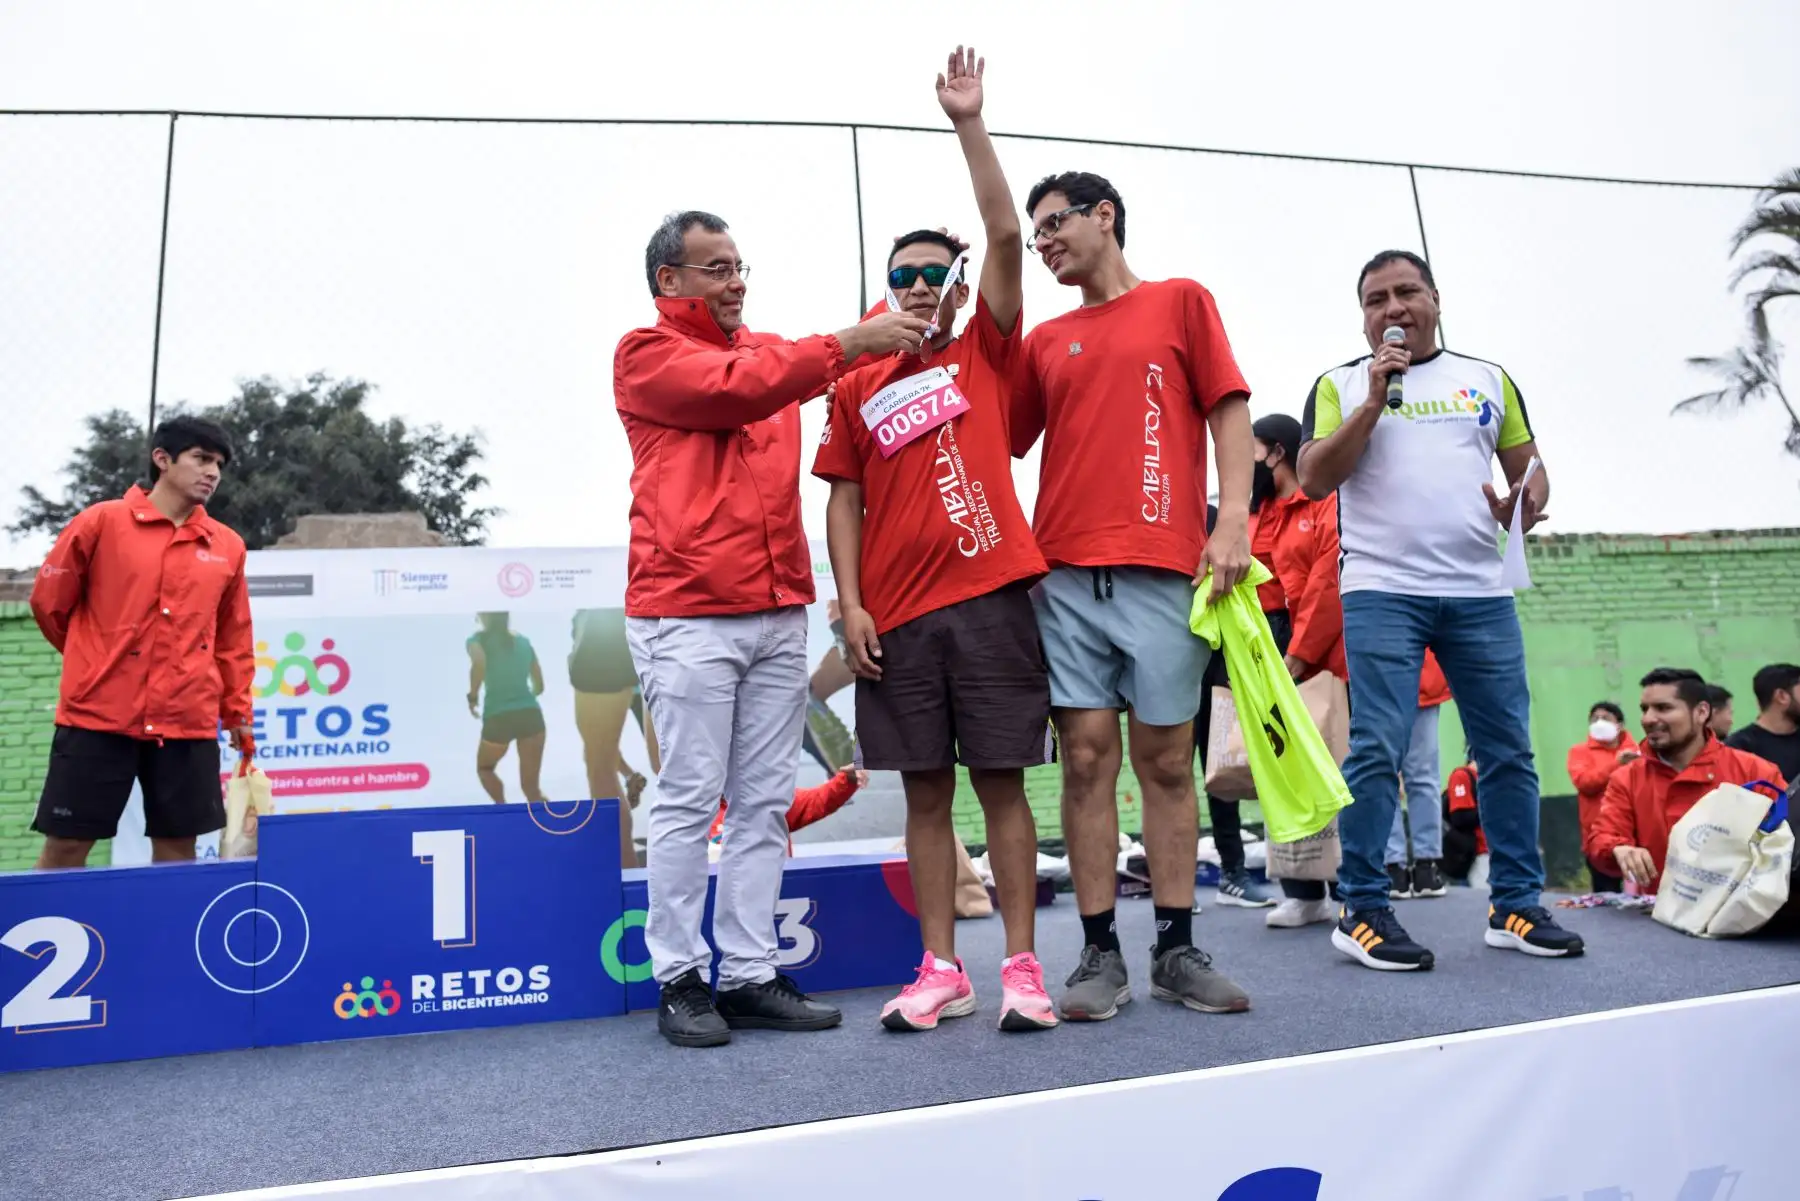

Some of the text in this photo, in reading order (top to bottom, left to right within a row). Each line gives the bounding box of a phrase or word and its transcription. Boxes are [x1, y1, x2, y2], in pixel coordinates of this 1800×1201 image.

[877, 387, 961, 446] 00674
[883, 388, 921, 414] CARRERA
[919, 384, 932, 395] 7K
[949, 443, 959, 455] DE
[1142, 393, 1161, 523] CABILDOS
[953, 455, 978, 513] BICENTENARIO
[1160, 473, 1170, 525] AREQUIPA
[971, 480, 1003, 548] TRUJILLO
[973, 515, 990, 552] FESTIVAL
[401, 571, 448, 584] Siempre
[306, 775, 350, 788] contra
[352, 773, 365, 786] el
[367, 771, 420, 785] hambre
[411, 829, 467, 942] 1
[775, 896, 816, 967] 3
[0, 916, 92, 1029] 2
[410, 964, 551, 1000] RETOS
[412, 991, 549, 1014] DEL BICENTENARIO
